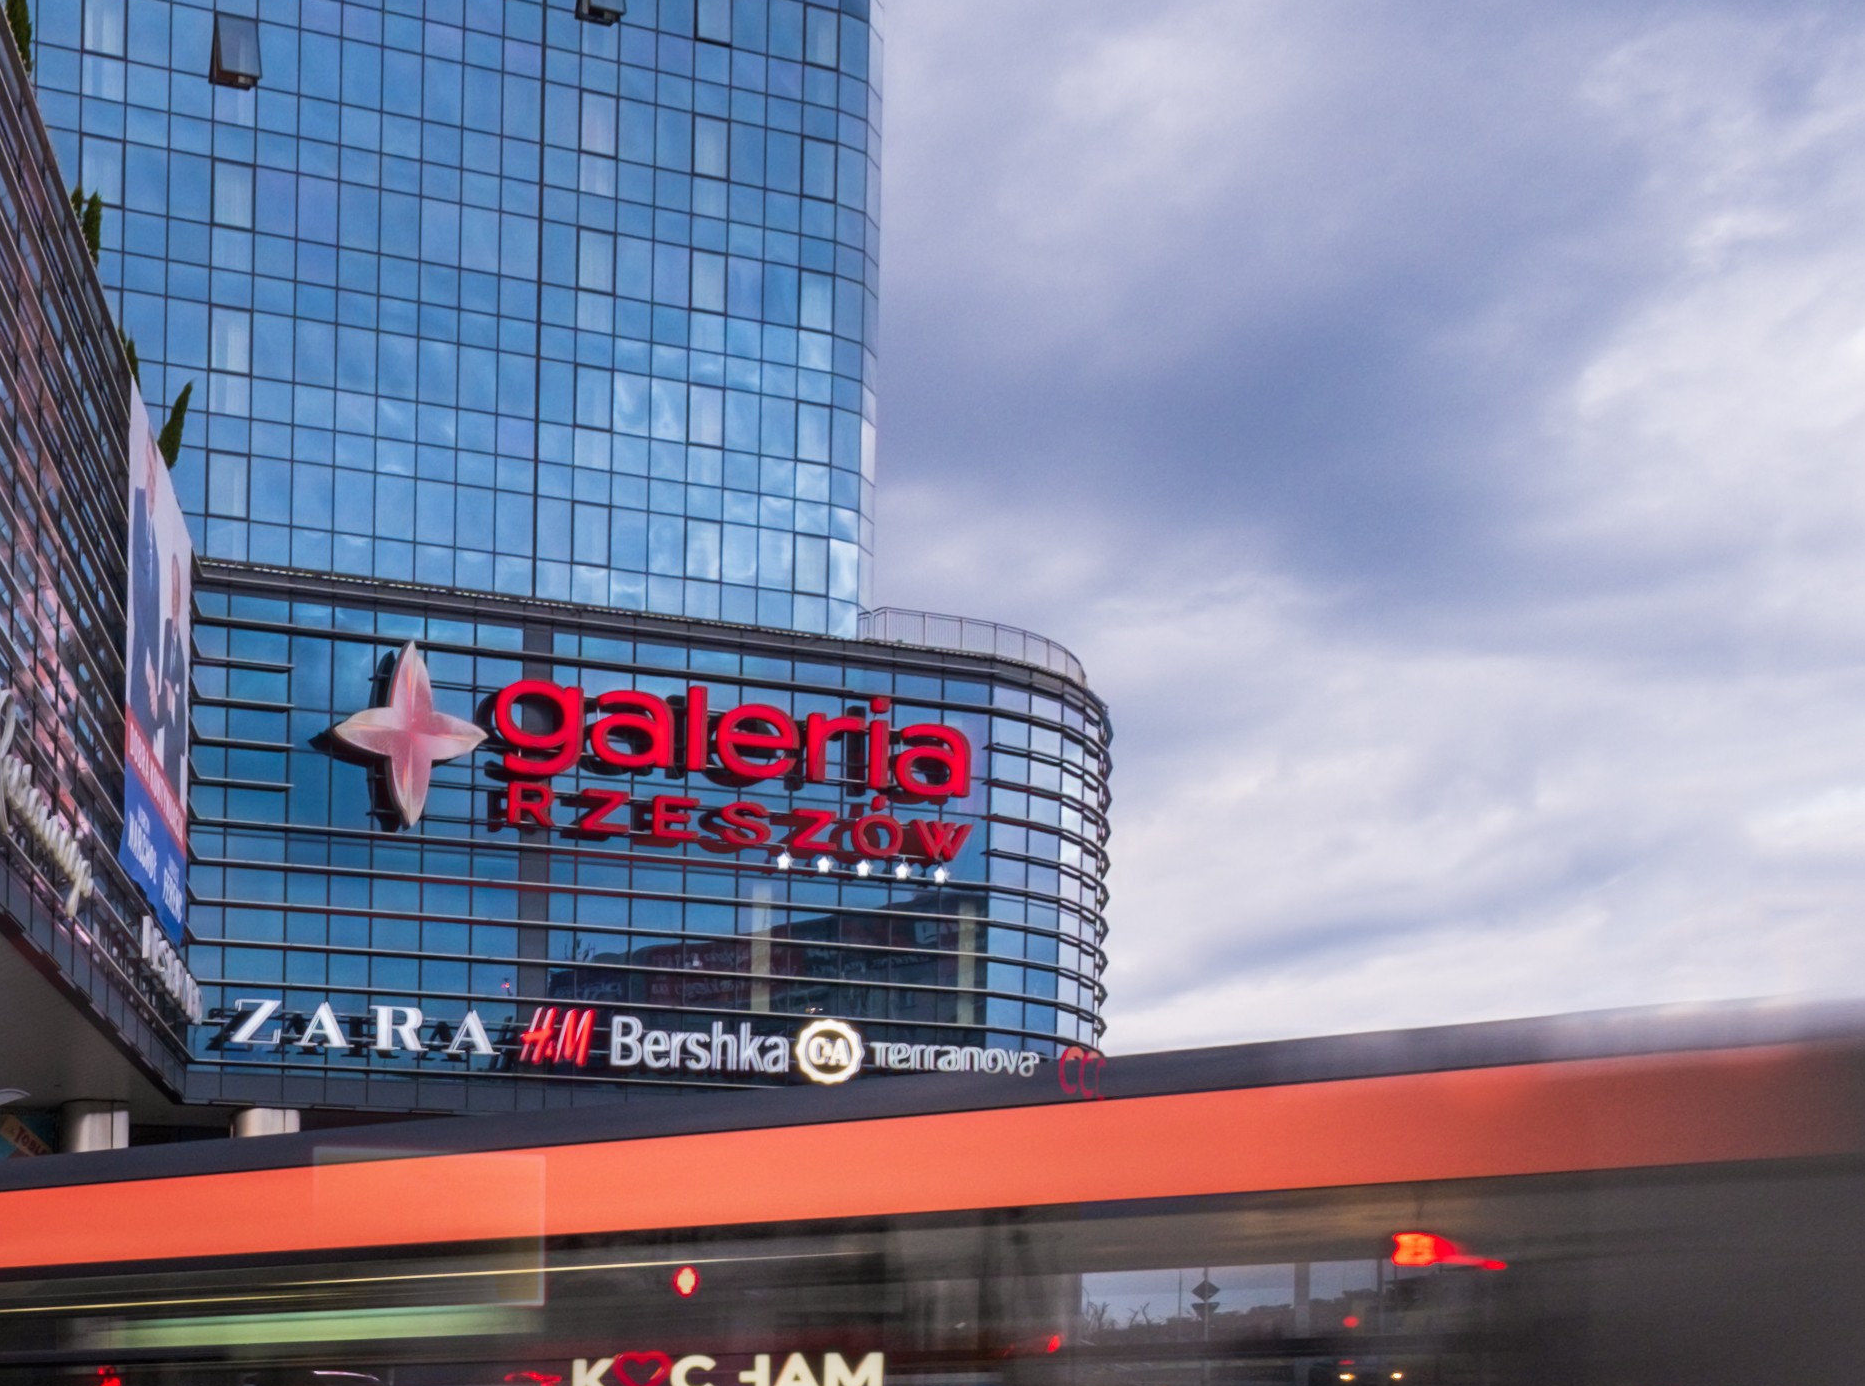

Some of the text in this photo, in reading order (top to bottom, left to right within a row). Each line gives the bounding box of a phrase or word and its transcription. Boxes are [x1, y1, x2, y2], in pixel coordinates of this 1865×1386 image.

[494, 679, 971, 797] galeria
[506, 780, 973, 862] RZESZÓW
[229, 999, 501, 1056] ZARA
[519, 1006, 596, 1067] H&M
[609, 1015, 790, 1073] Bershka
